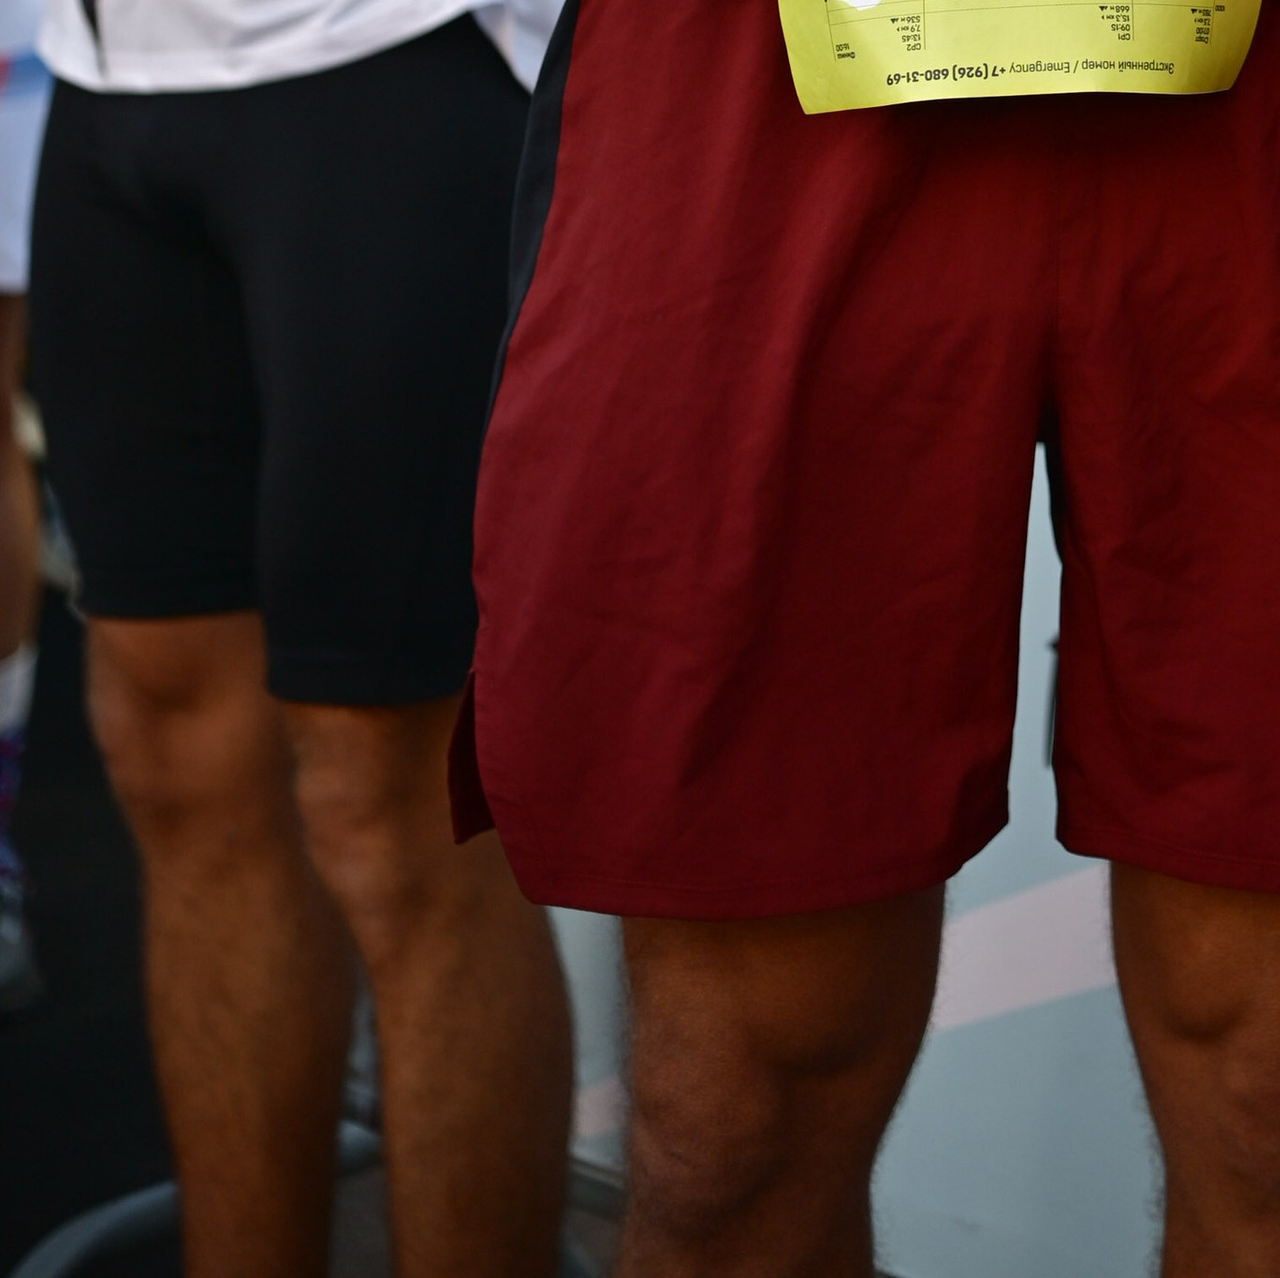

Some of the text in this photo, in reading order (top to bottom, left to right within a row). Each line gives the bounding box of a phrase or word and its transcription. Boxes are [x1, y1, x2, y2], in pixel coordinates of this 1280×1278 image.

[992, 64, 1006, 78] +7
[1009, 62, 1071, 73] Emergency
[1081, 58, 1116, 71] номер
[1118, 60, 1175, 75] Экстренный
[886, 67, 949, 86] 680-31-69
[952, 63, 989, 82] (926)
